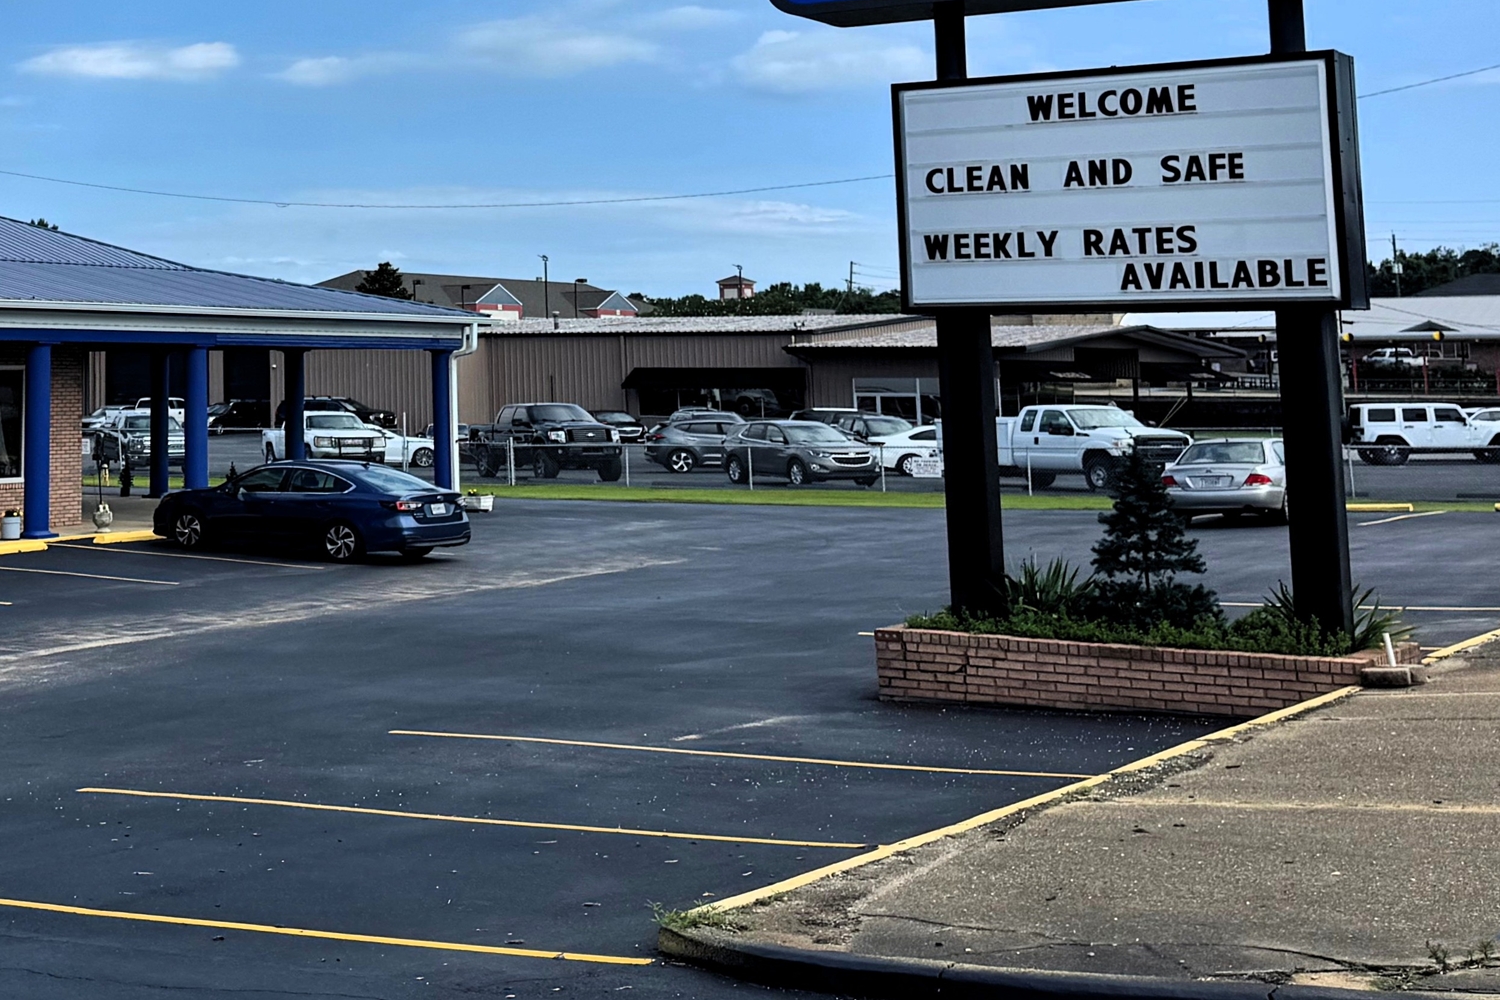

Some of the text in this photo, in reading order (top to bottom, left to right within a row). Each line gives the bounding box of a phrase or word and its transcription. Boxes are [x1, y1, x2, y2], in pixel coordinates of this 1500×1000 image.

[1026, 83, 1197, 122] WELCOME
[925, 152, 1245, 194] CLEAN AND SAFE
[923, 225, 1198, 261] WEEKLY RATES
[1120, 257, 1328, 291] AVAILABLE
